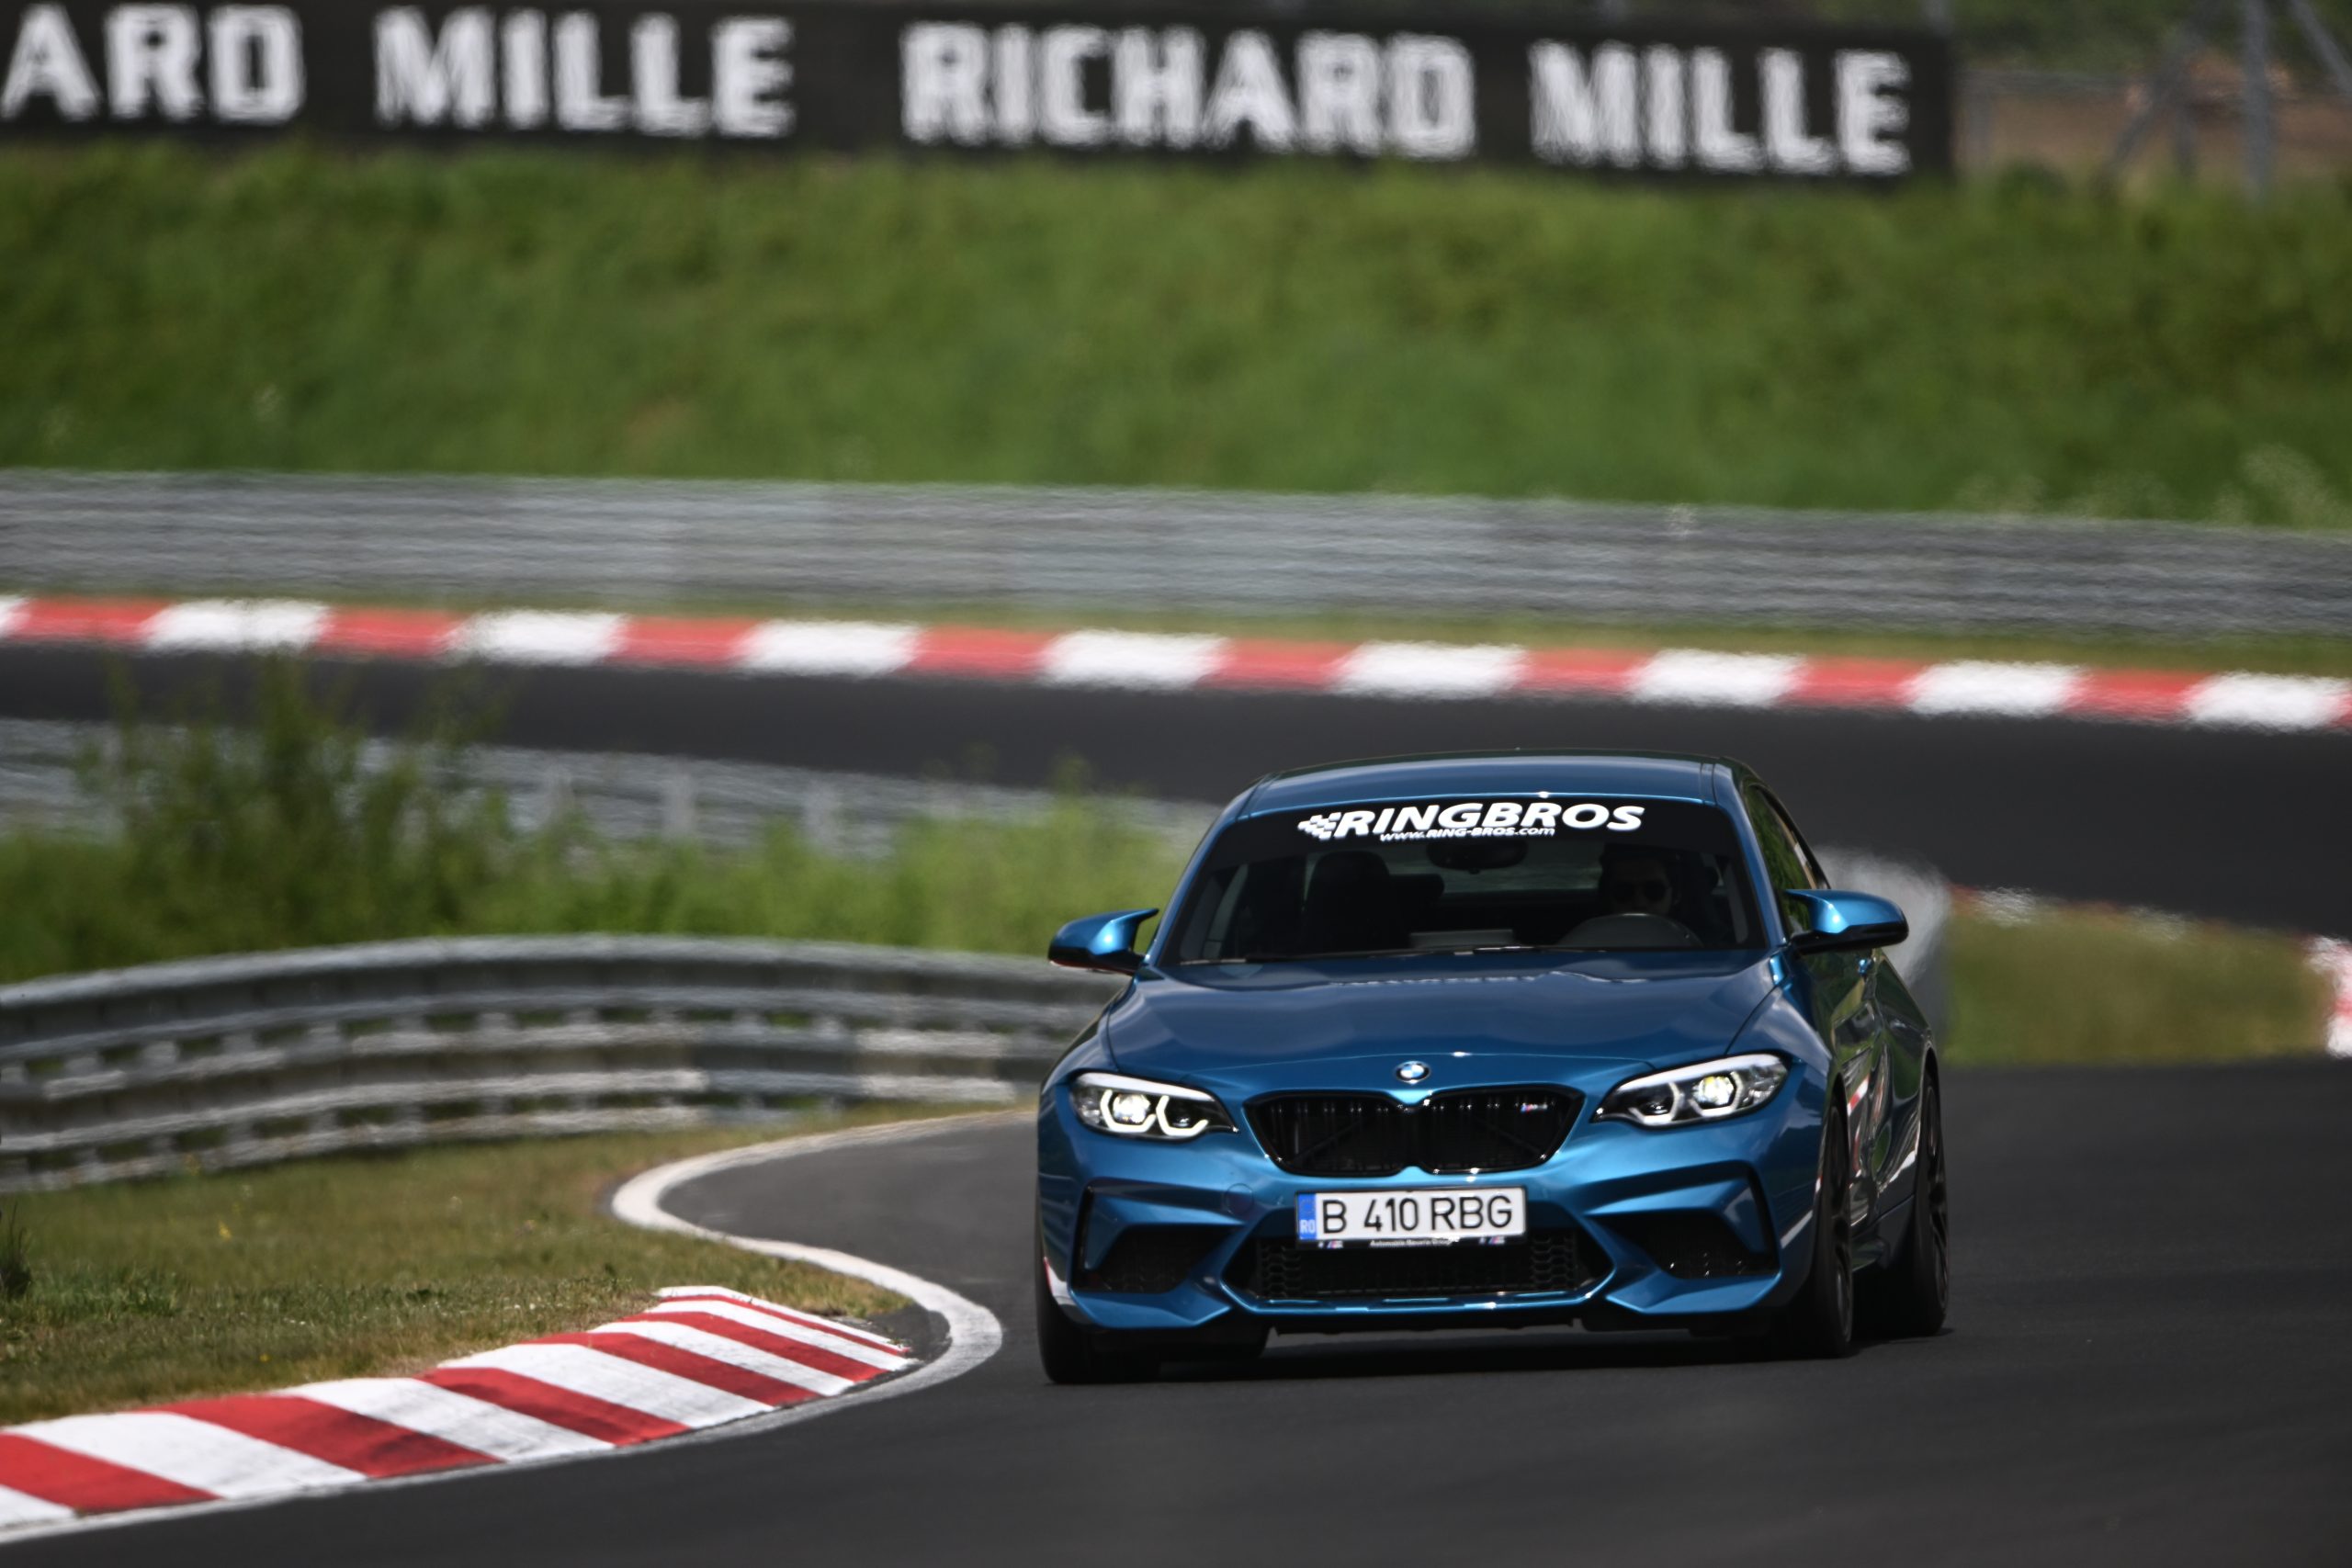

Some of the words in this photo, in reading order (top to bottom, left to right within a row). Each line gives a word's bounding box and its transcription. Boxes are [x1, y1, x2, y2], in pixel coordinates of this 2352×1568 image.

[0, 3, 304, 123] ARD
[374, 6, 796, 138] MILLE
[900, 22, 1476, 161] RICHARD
[1529, 40, 1911, 175] MILLE
[1332, 802, 1645, 840] RINGBROS
[1380, 827, 1555, 842] www.RING-BROS.com
[1299, 1219, 1316, 1235] RO
[1322, 1199, 1348, 1235] B
[1363, 1197, 1419, 1233] 410
[1430, 1194, 1513, 1231] RBG
